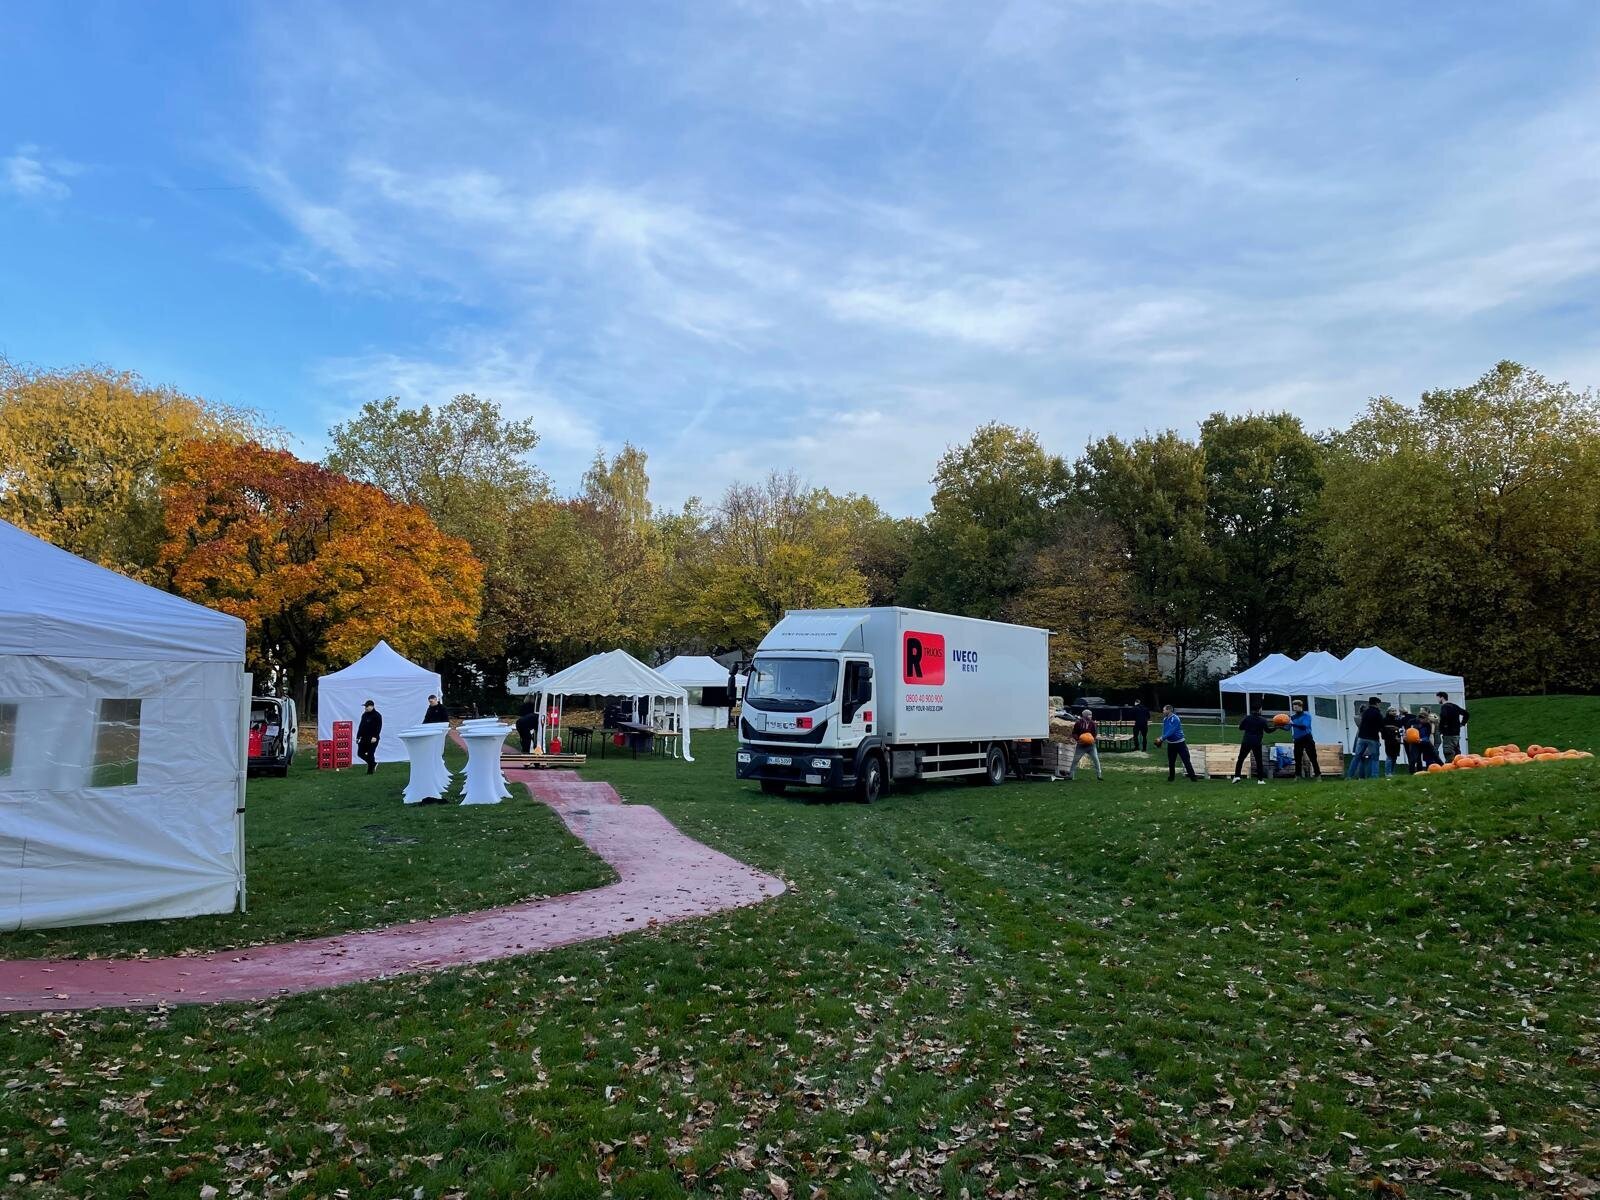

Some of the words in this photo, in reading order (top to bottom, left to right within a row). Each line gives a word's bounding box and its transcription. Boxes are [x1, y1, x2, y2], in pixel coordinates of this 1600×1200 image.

[907, 638, 923, 678] R
[924, 647, 943, 658] TRUCKS
[953, 649, 978, 663] IVECO
[962, 664, 978, 673] RENT
